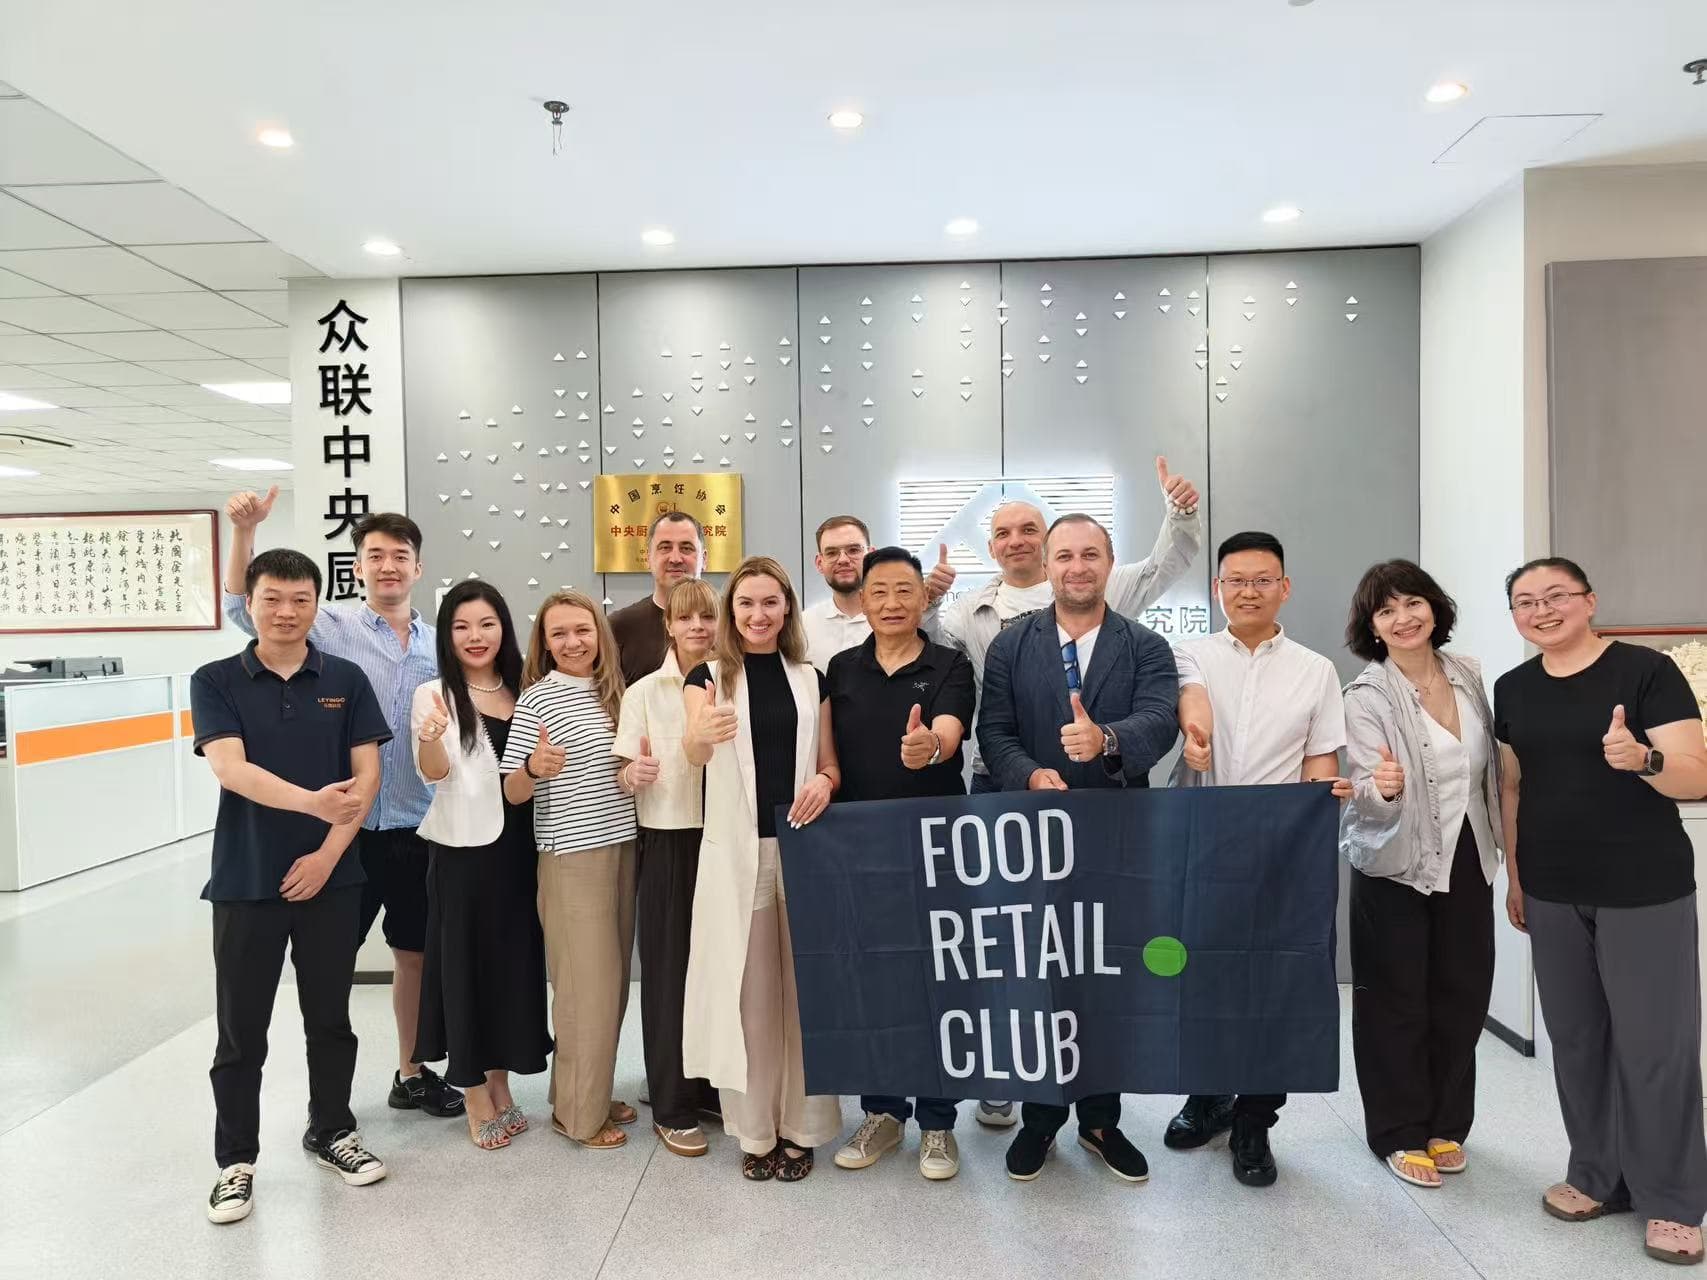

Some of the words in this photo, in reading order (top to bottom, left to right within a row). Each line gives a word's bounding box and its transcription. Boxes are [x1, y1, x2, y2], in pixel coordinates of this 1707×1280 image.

[317, 300, 373, 601] 众联中央厨
[610, 483, 726, 516] 中国烹饪协会
[1146, 605, 1207, 633] 究院
[920, 808, 1075, 888] FOOD
[929, 901, 1121, 981] RETAIL
[939, 1008, 1081, 1084] CLUB
